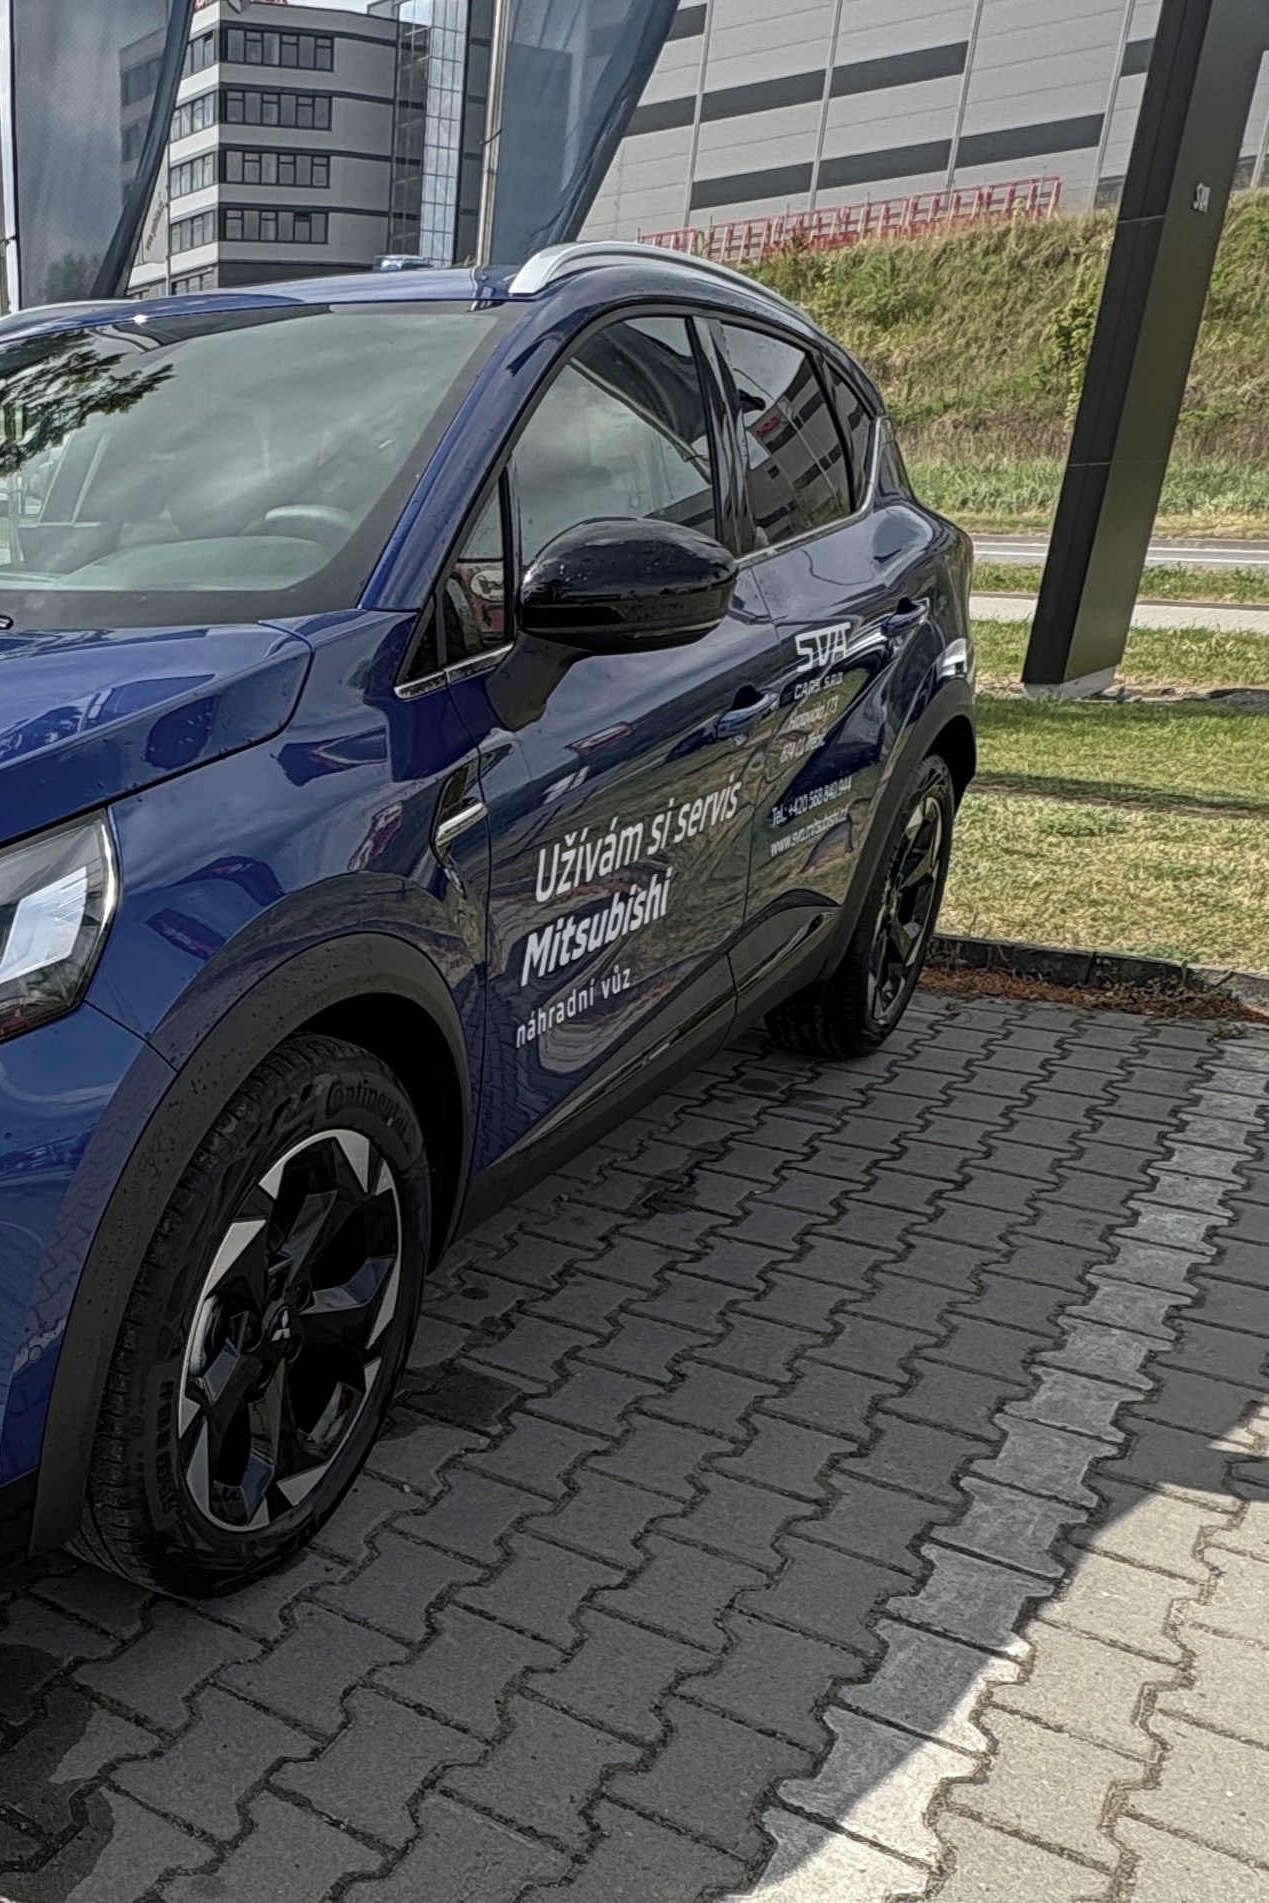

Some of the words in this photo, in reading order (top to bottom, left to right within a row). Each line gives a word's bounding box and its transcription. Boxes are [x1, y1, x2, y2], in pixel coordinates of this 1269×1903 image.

[795, 621, 851, 673] SVA
[534, 816, 644, 904] Užívám
[647, 798, 674, 856] si
[673, 772, 742, 843] servis
[520, 866, 673, 987] Mitsubishi
[515, 977, 595, 1049] náhradní
[602, 963, 632, 999] vůz
